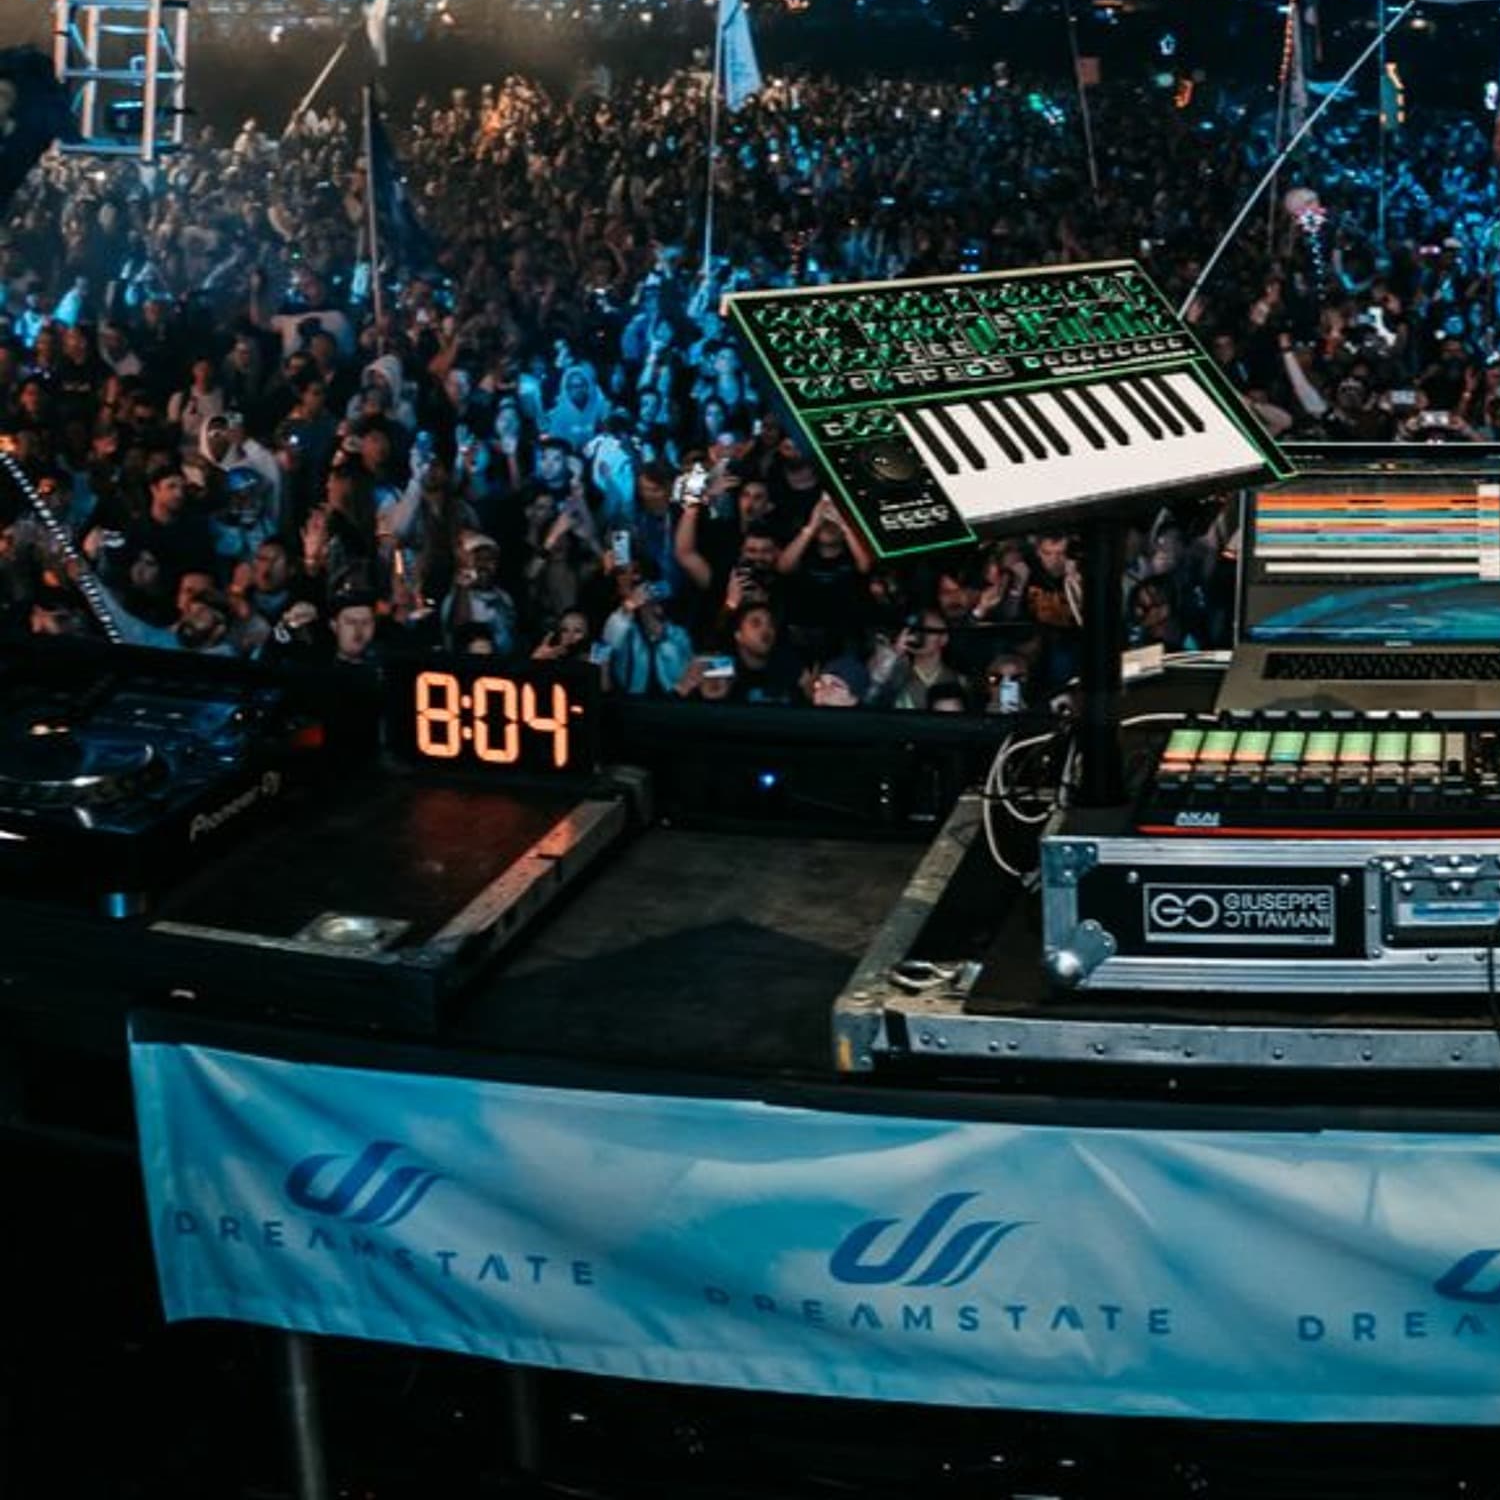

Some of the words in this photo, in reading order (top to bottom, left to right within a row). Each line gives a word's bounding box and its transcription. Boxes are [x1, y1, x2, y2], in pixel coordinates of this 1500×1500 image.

[416, 671, 568, 769] 8:04
[1174, 812, 1221, 826] AKAI
[1223, 893, 1329, 910] GIUSEPPE
[1223, 911, 1330, 928] OTTAVIANI
[174, 1209, 597, 1286] DREAMSTATE
[702, 1286, 1174, 1335] DREAMSTATE
